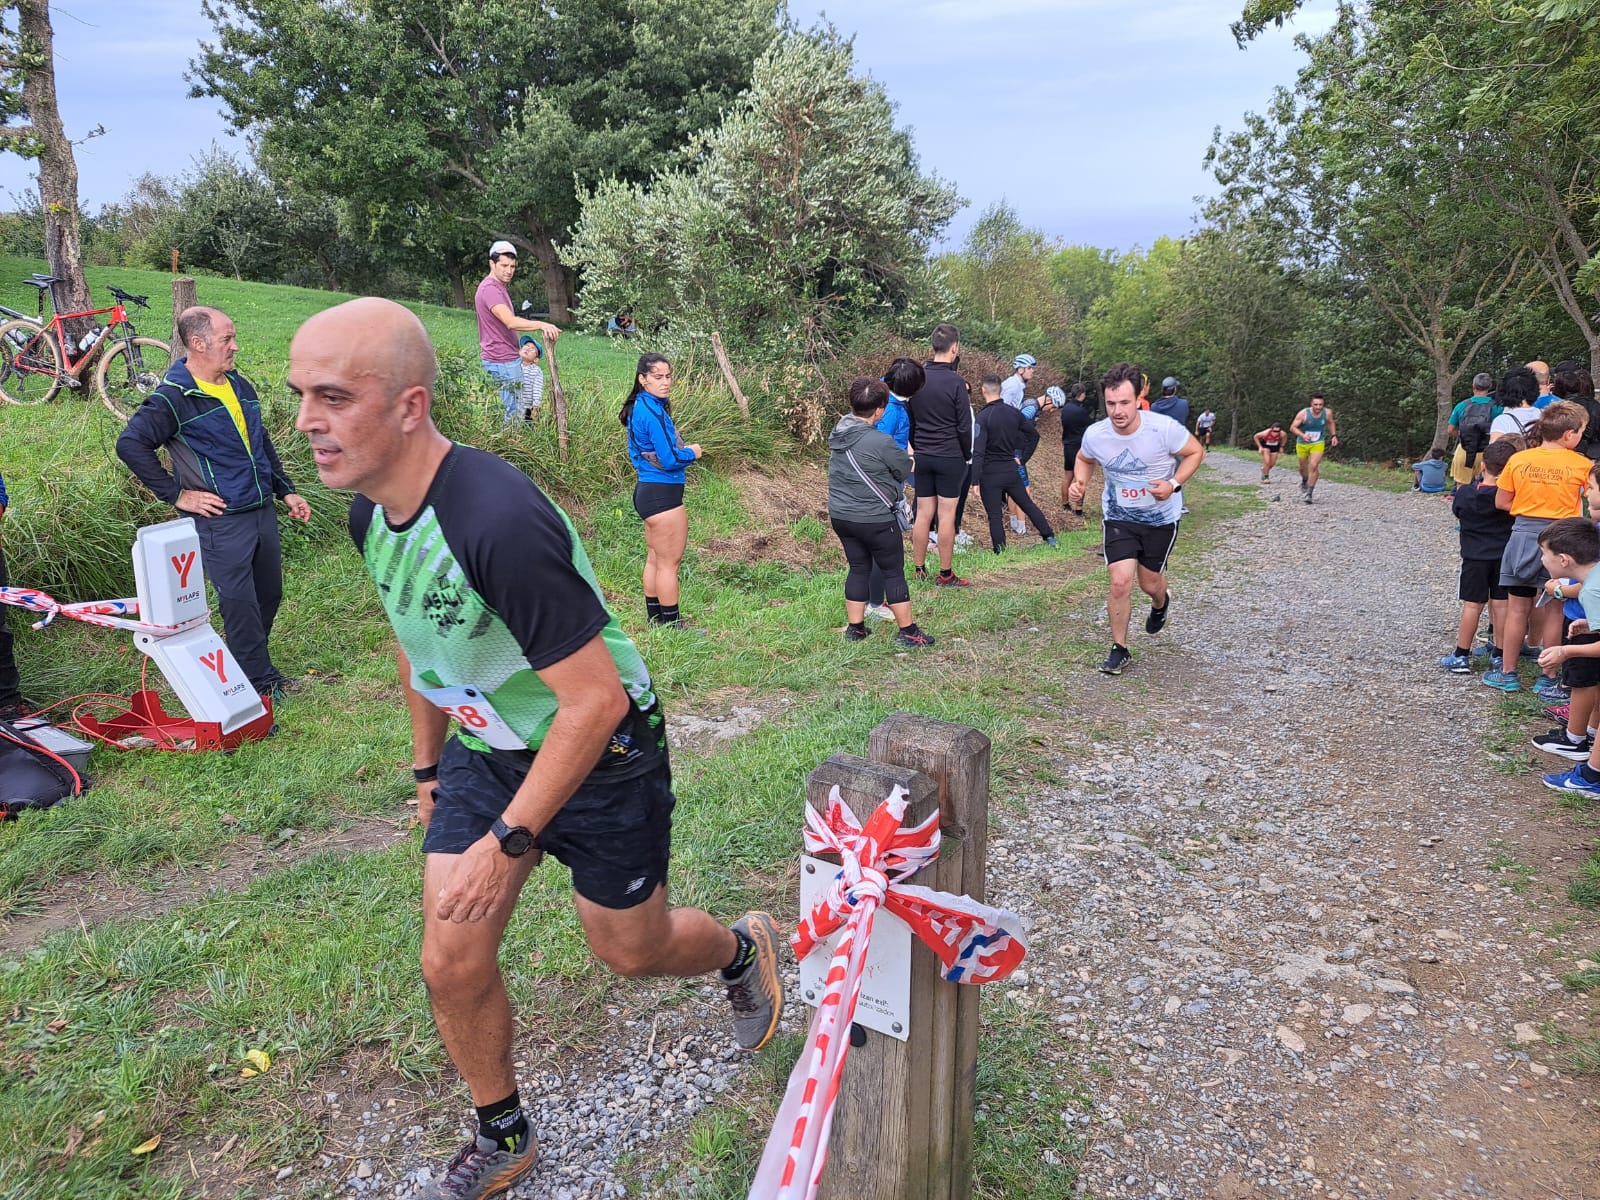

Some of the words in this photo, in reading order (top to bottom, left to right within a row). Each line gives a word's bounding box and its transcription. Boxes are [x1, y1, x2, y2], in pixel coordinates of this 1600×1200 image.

[1121, 487, 1147, 498] 501
[176, 590, 201, 603] MYLAPS
[222, 682, 246, 697] MYLAPS
